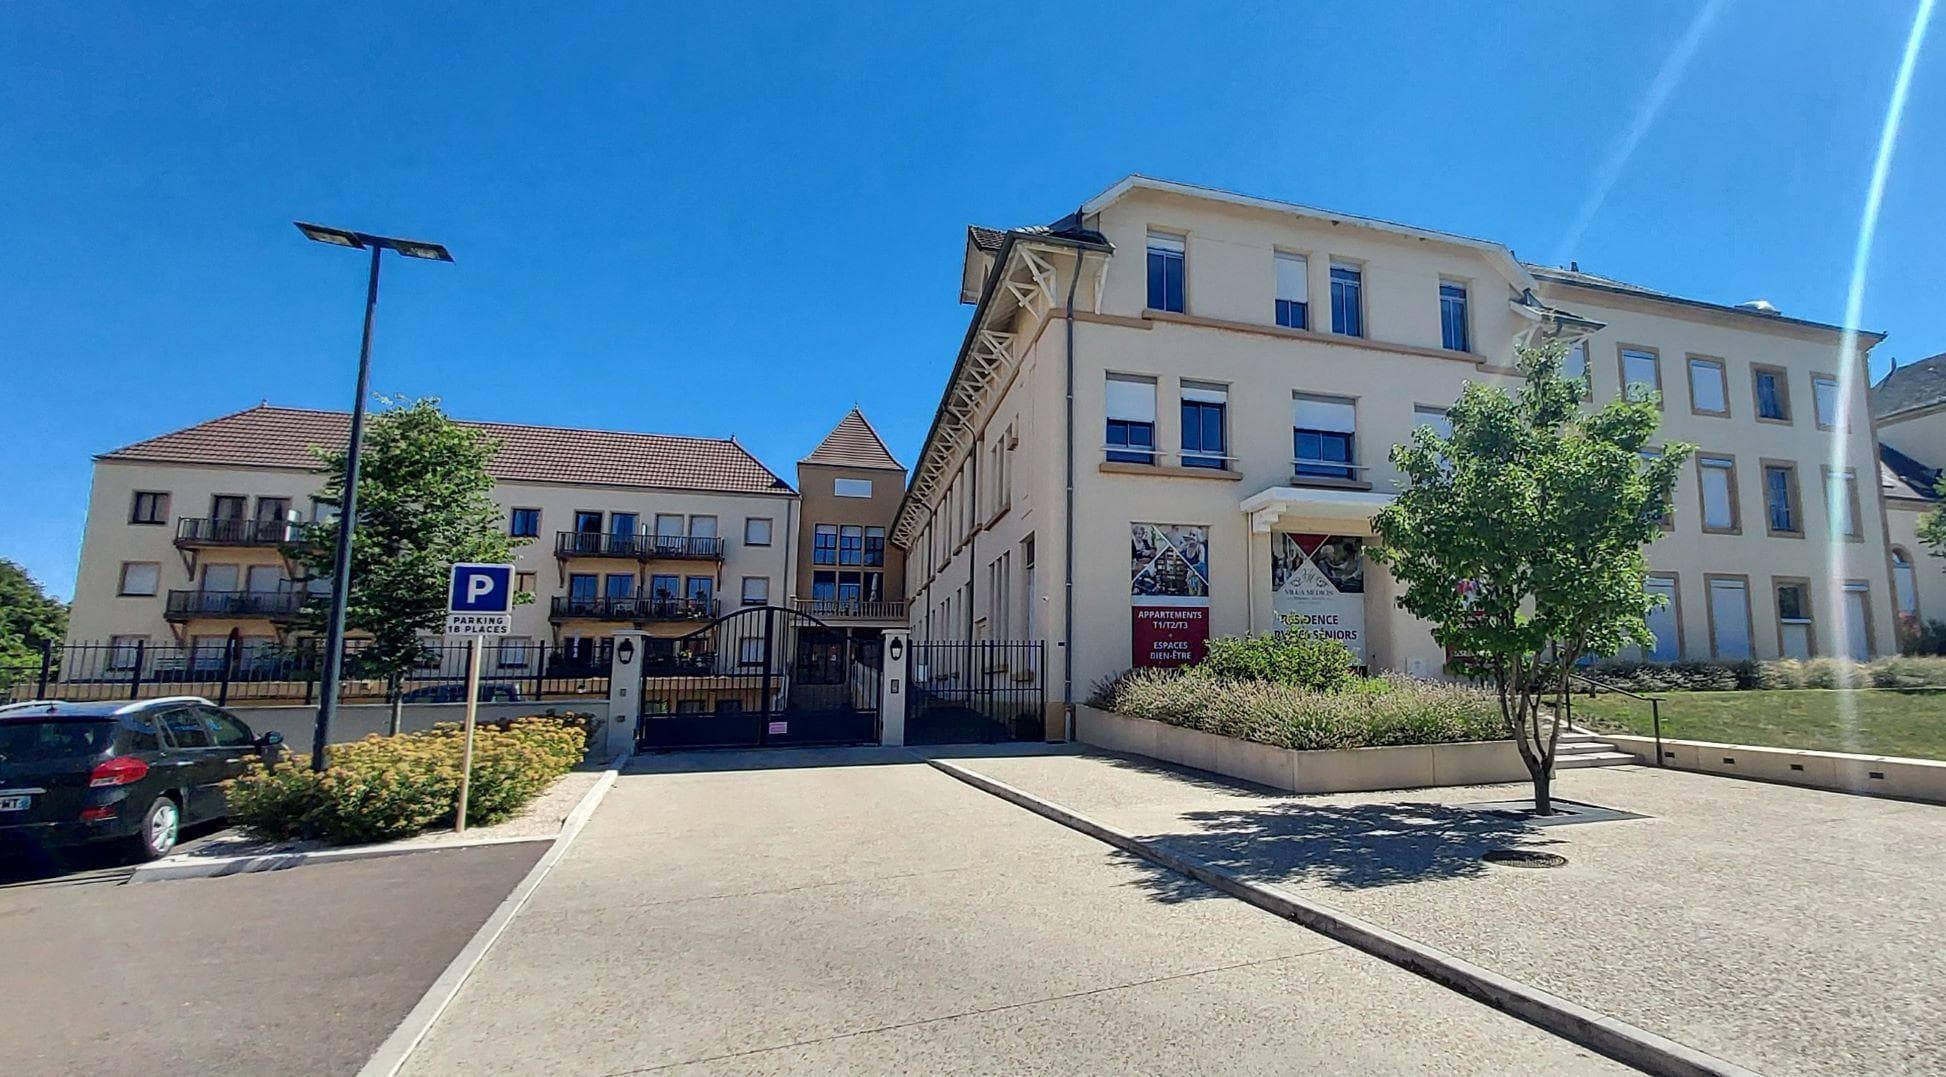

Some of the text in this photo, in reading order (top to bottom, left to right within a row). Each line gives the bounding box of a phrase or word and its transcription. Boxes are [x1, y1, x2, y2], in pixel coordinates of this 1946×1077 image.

[466, 574, 495, 604] P
[1138, 610, 1203, 619] APPARTEMENTS
[453, 616, 504, 625] PARKING
[1152, 621, 1189, 629] T1/T2/T3
[448, 625, 508, 634] 18 PLACES
[1153, 641, 1188, 650] ESPACES
[1150, 650, 1193, 660] BIEN-ÊTRE
